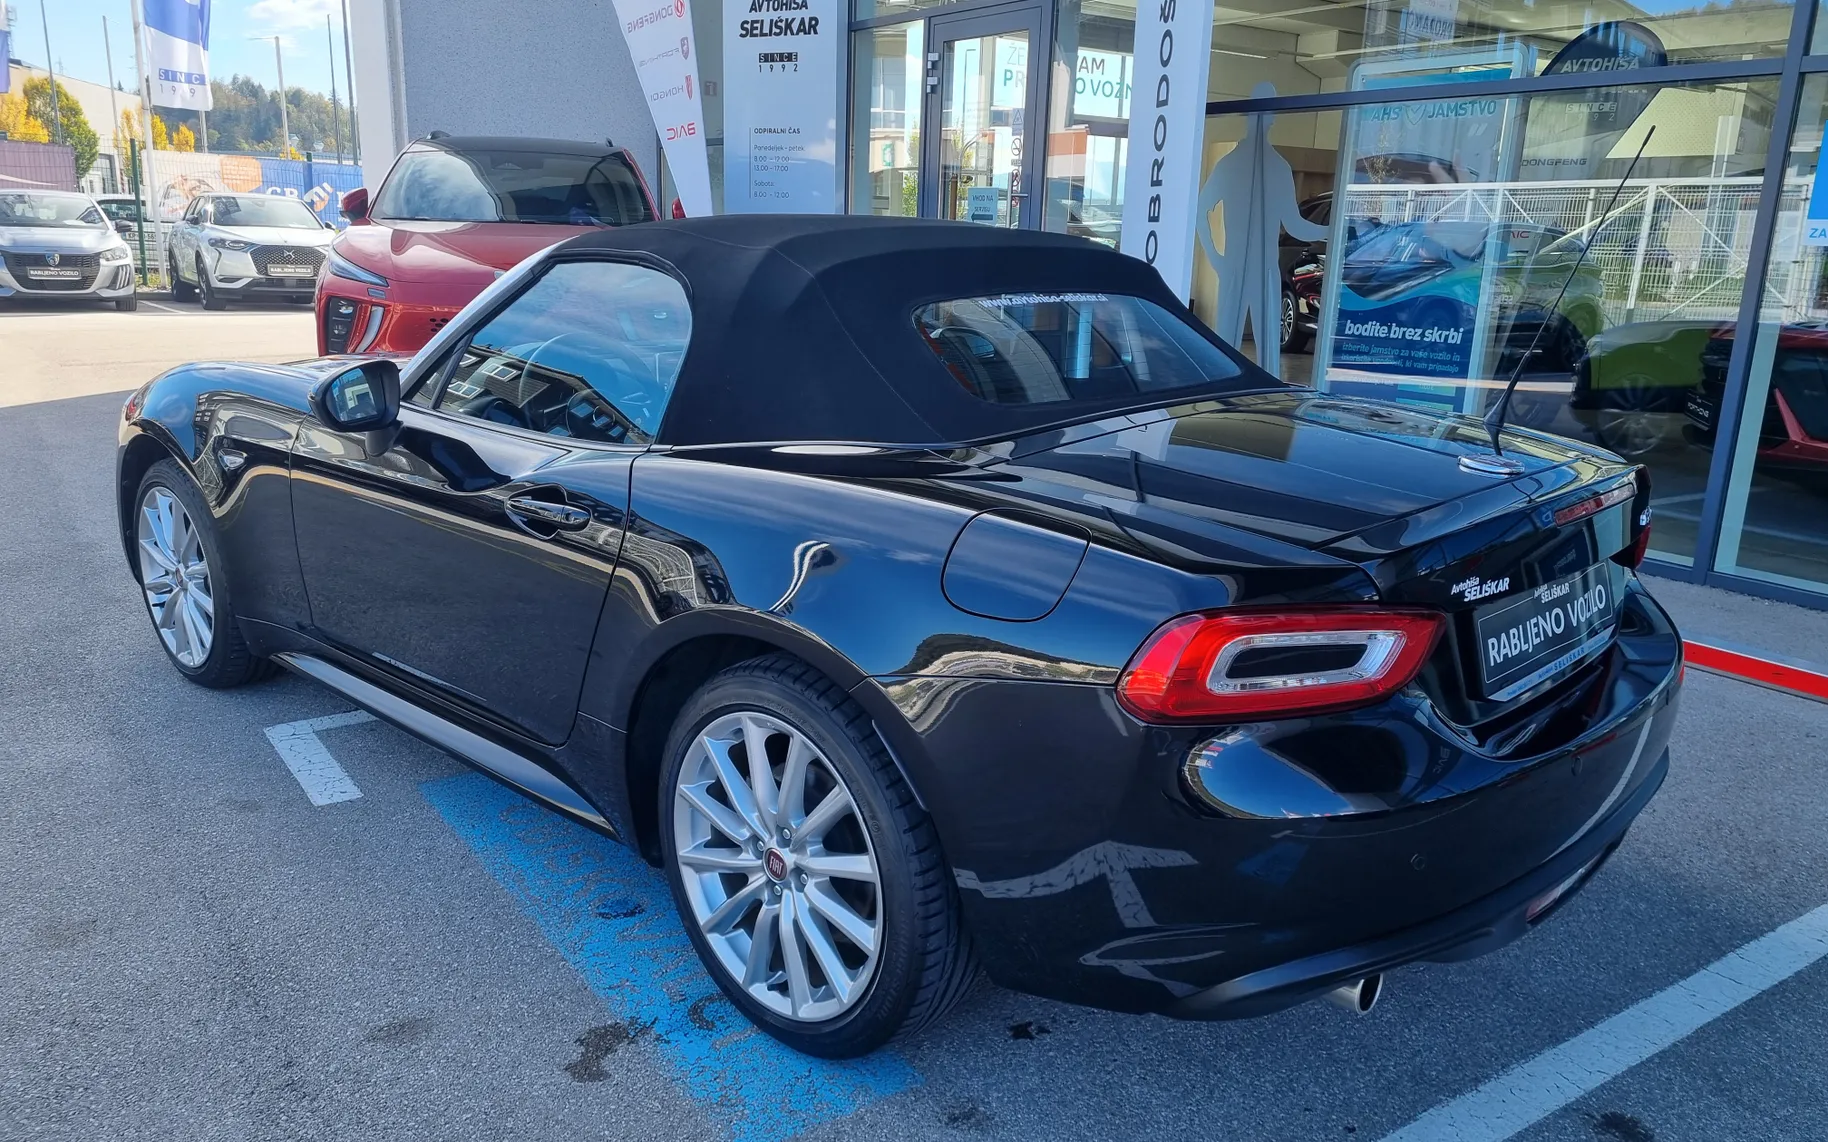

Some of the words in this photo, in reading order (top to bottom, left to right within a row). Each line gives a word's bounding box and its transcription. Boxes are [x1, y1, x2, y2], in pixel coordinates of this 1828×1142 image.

[739, 16, 819, 38] SELIŠKAR
[760, 53, 797, 62] SINCE
[160, 70, 200, 84] SINC
[1371, 107, 1400, 122] AHS
[1428, 101, 1497, 119] JAMSTVO
[1145, 0, 1177, 265] OBRODOŠ
[1521, 159, 1587, 167] DONGFENG
[1345, 320, 1388, 337] bodite
[1390, 323, 1422, 341] brez
[1423, 326, 1464, 345] skrbi
[1451, 576, 1480, 596] Avtohiša
[1464, 578, 1510, 602] SELIŠKAR
[1487, 607, 1565, 667] RABLJENO
[1567, 584, 1606, 627] VOZILO
[770, 856, 784, 876] FIAT
